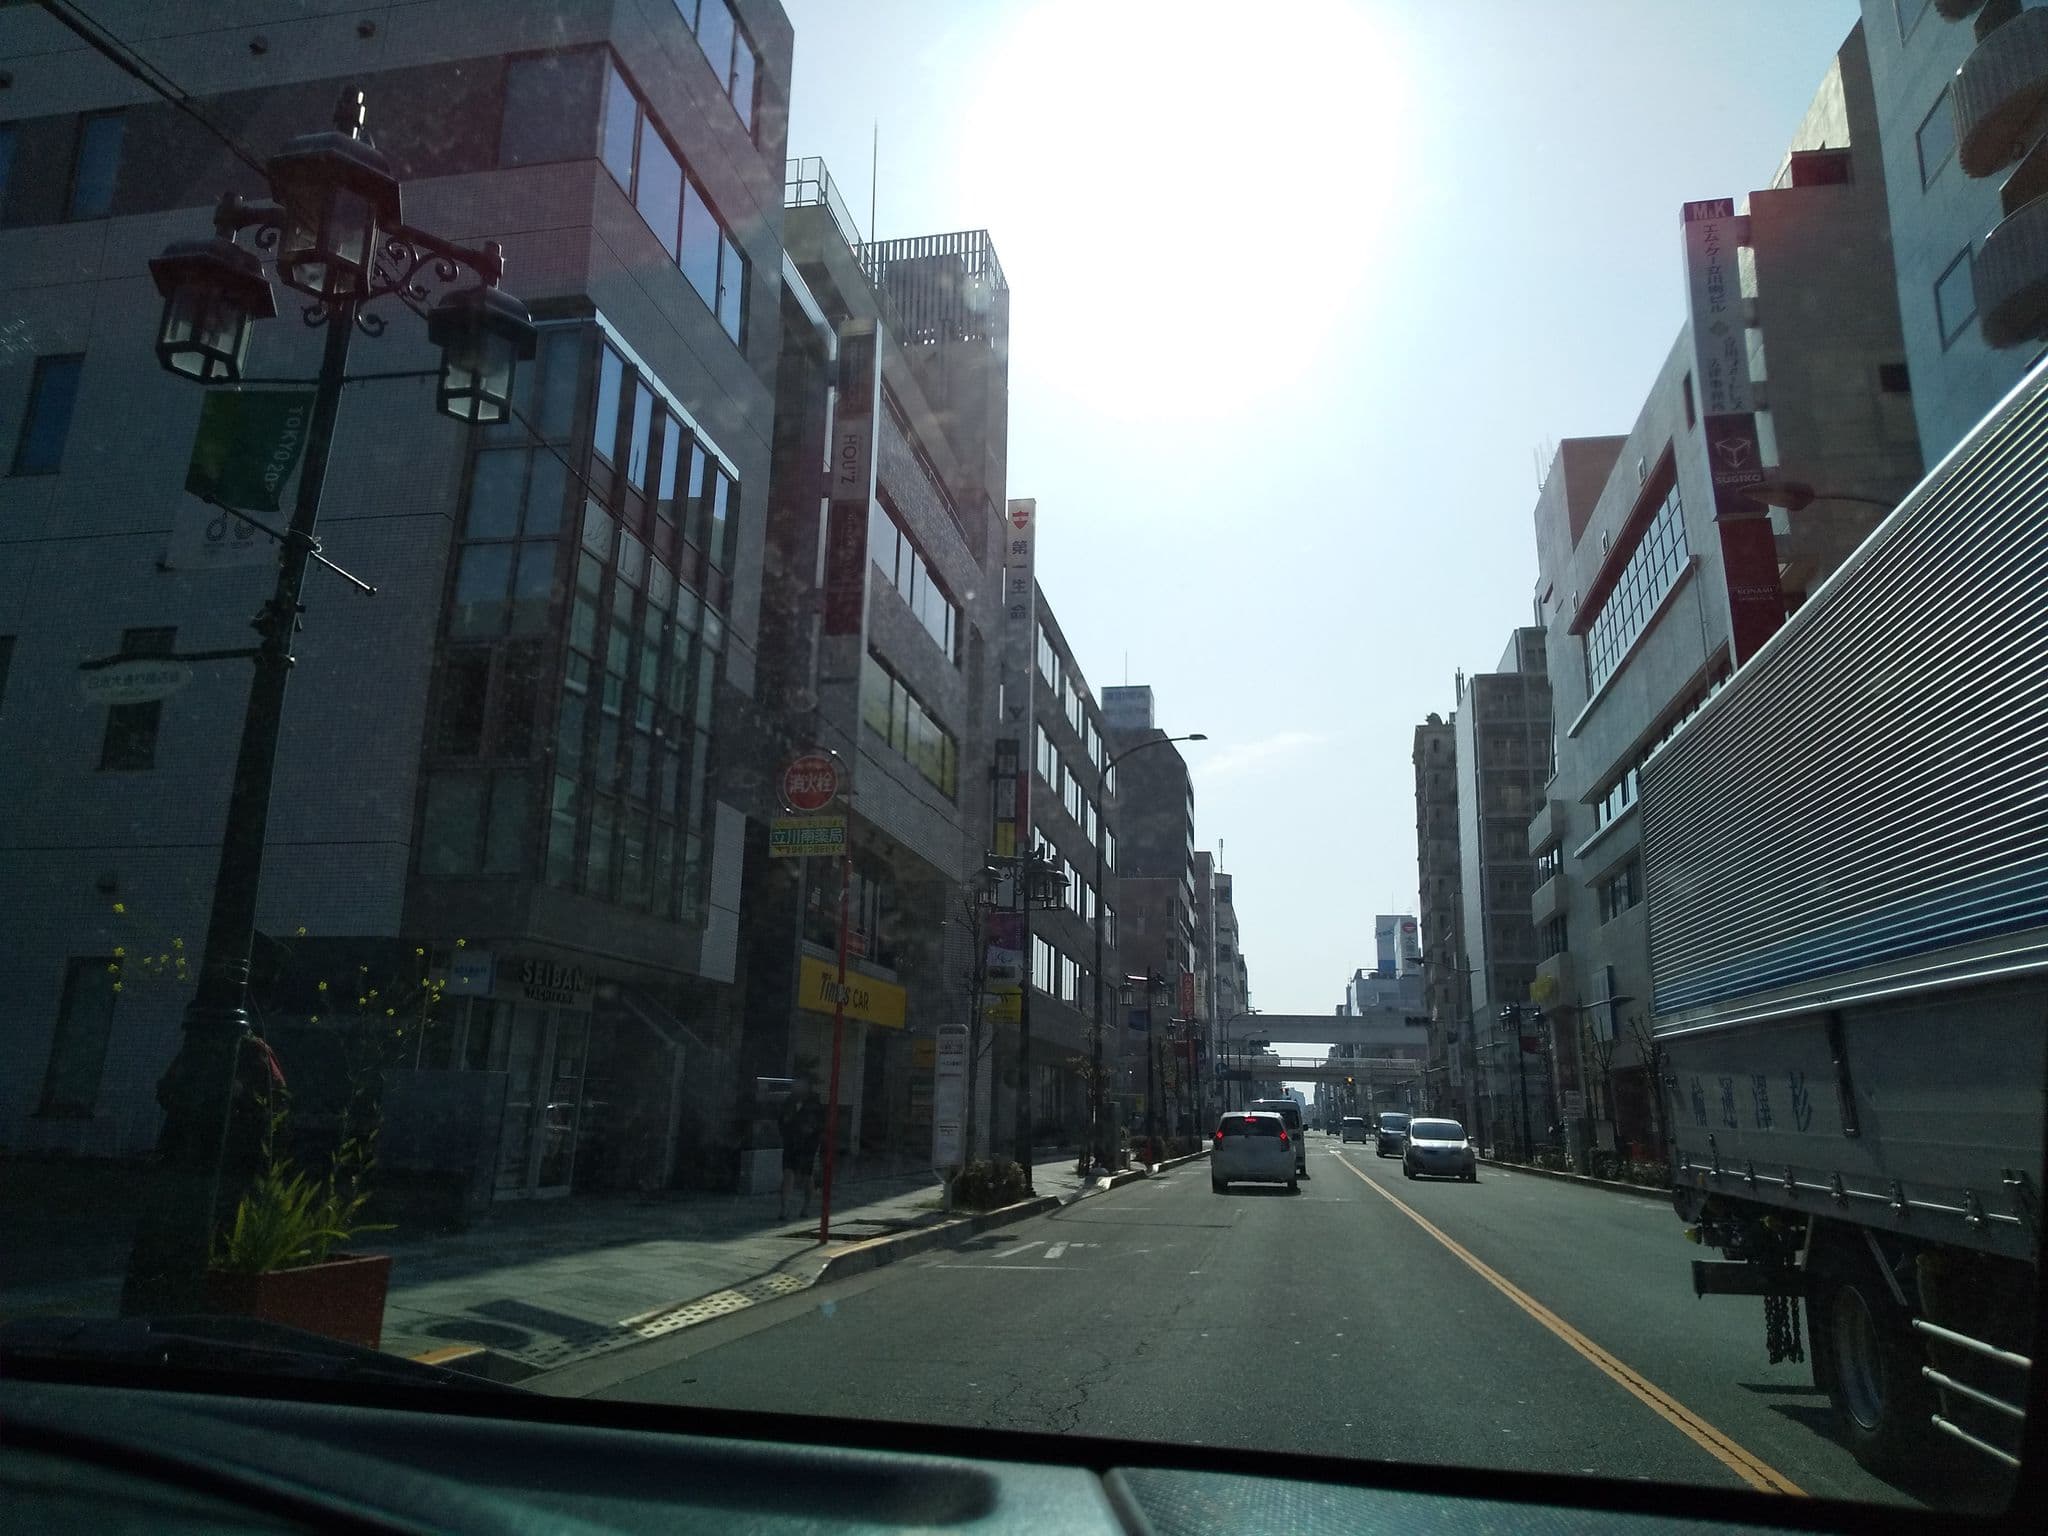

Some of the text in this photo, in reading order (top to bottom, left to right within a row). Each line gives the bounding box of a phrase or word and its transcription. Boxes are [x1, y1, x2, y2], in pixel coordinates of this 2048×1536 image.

[789, 771, 834, 793] 消火栓
[771, 828, 843, 845] 立川南薬局
[819, 972, 870, 1012] Tims CAR
